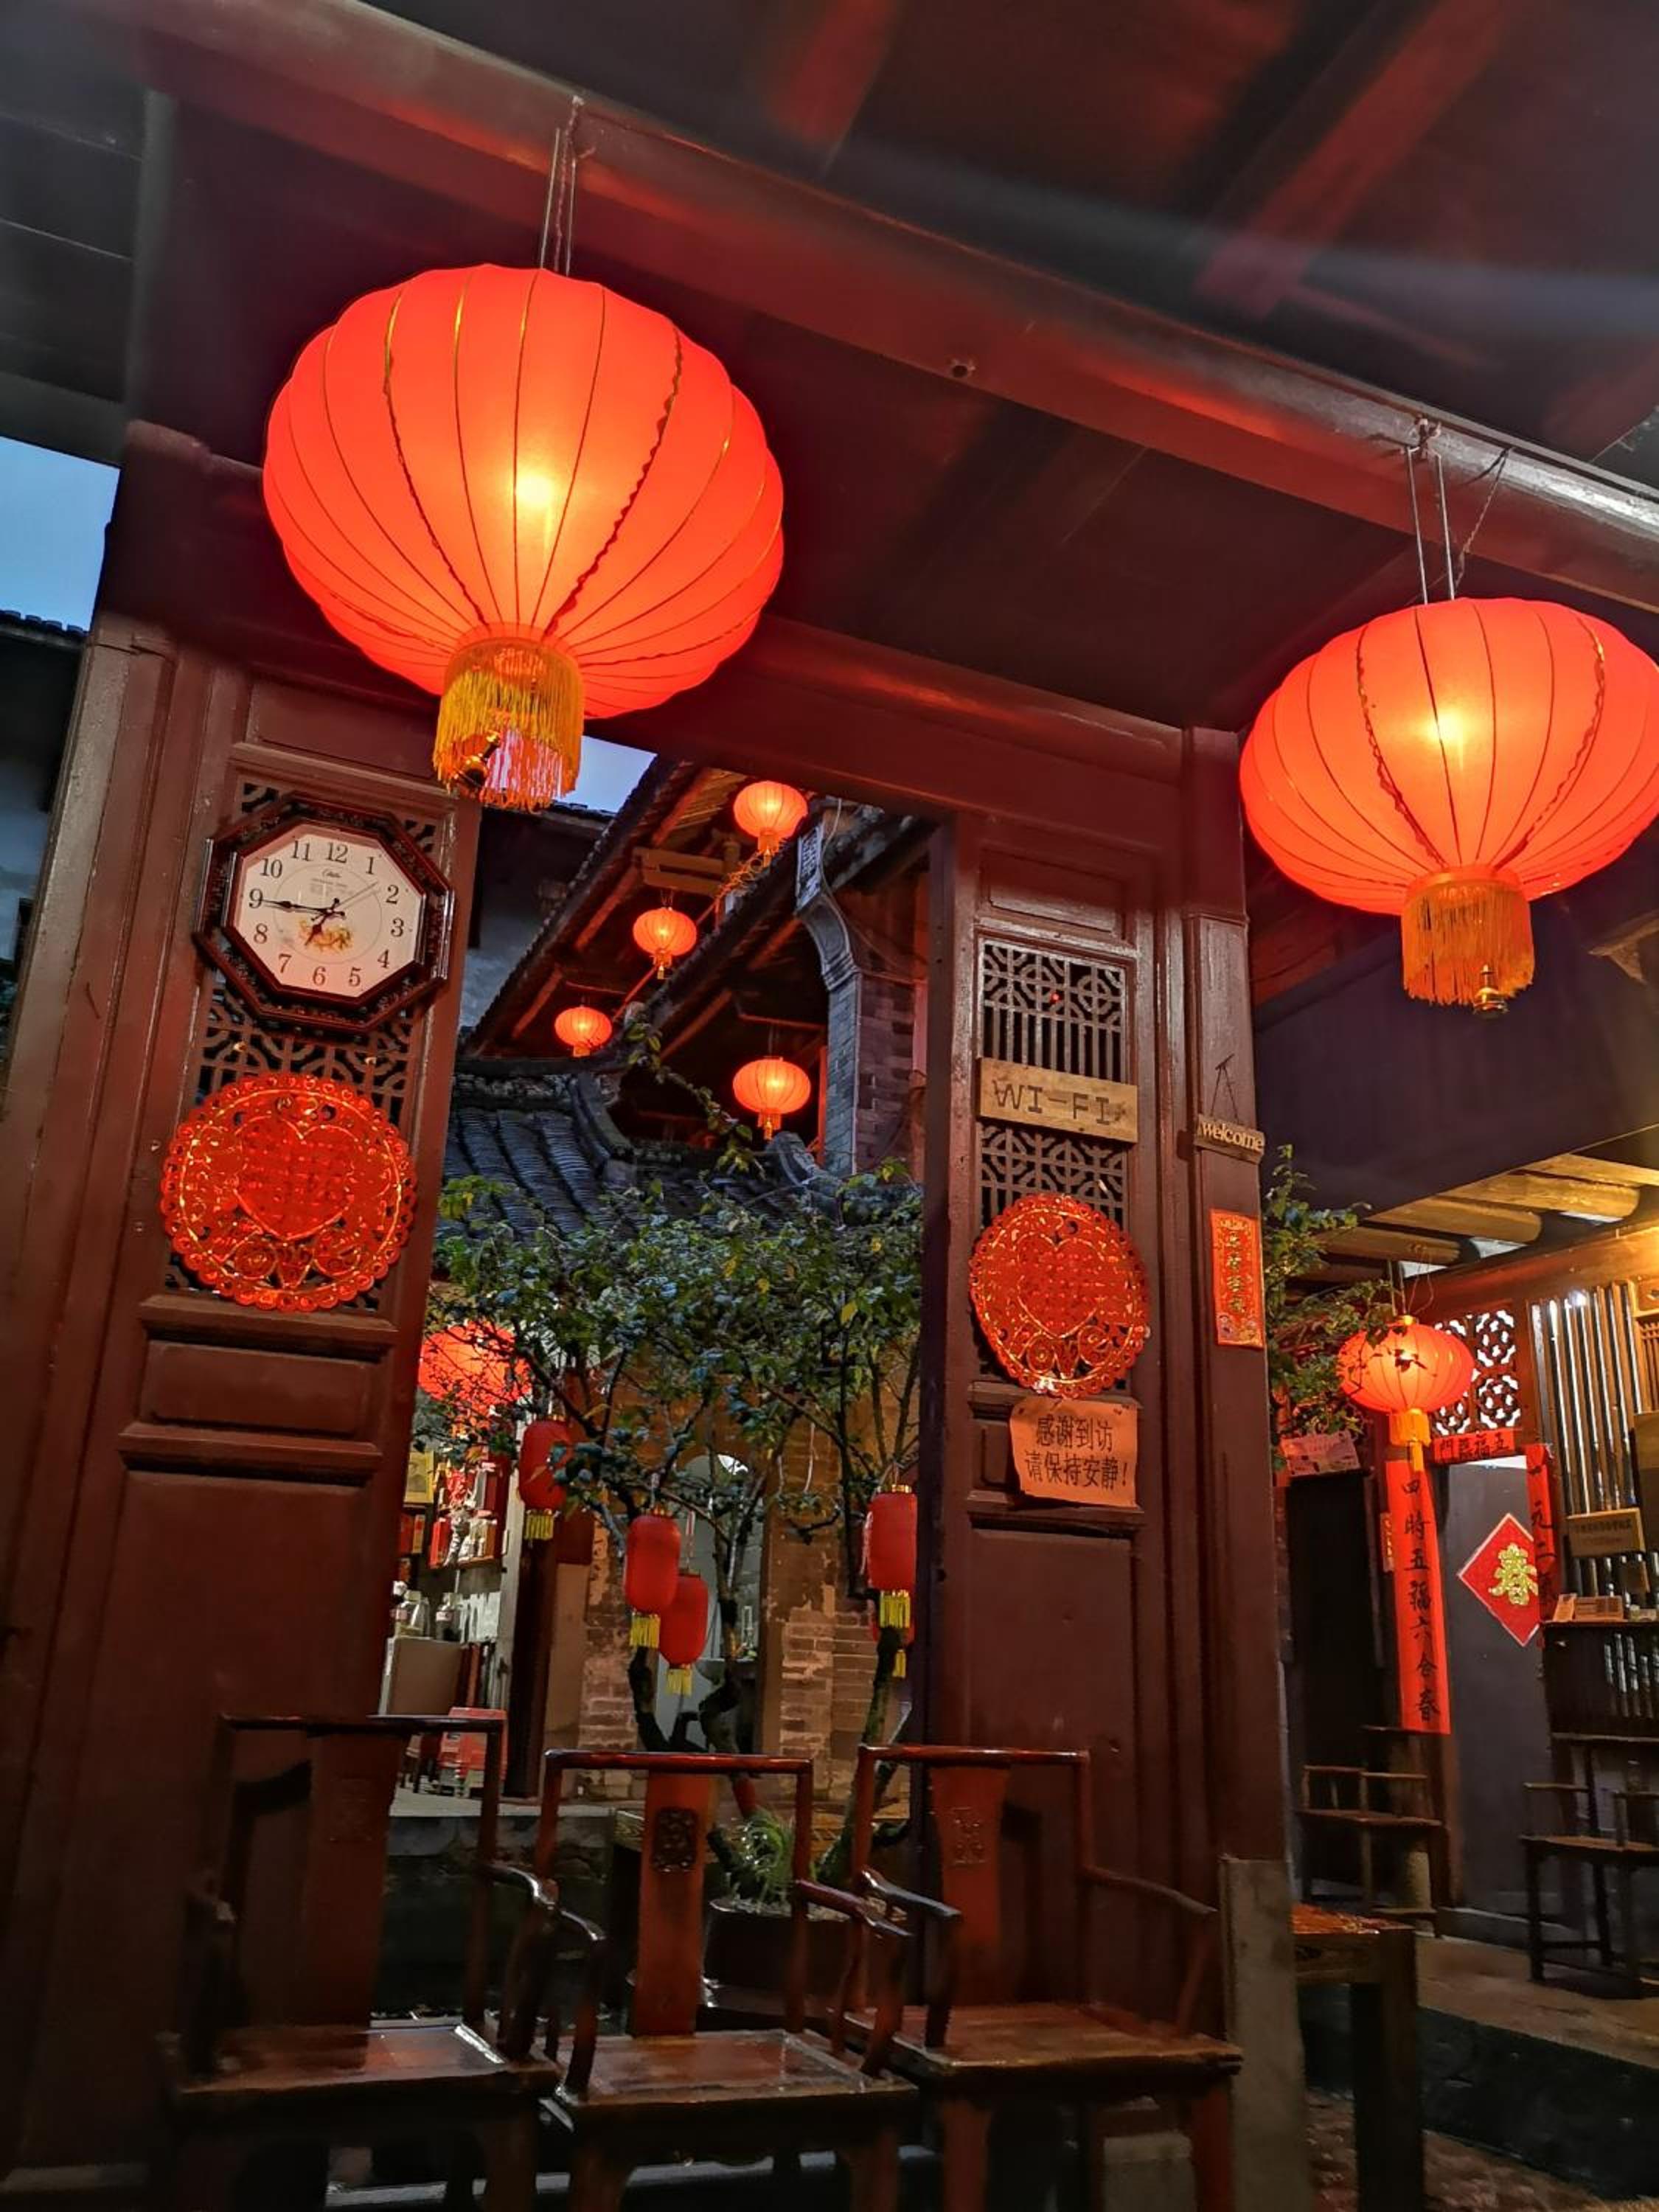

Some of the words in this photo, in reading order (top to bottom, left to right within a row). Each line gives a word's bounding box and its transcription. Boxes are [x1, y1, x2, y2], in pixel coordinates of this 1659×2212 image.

[291, 840, 312, 861] 11
[324, 842, 349, 863] 12
[260, 858, 283, 878] 10
[365, 856, 375, 874] 1
[248, 888, 264, 909] 9
[386, 884, 400, 904] 2
[253, 924, 268, 944] 8
[390, 917, 405, 938] 3
[278, 953, 292, 973] 7
[377, 949, 390, 969] 4
[313, 967, 326, 986] 6
[349, 967, 361, 987] 5
[992, 1079, 1110, 1125] WI-FI
